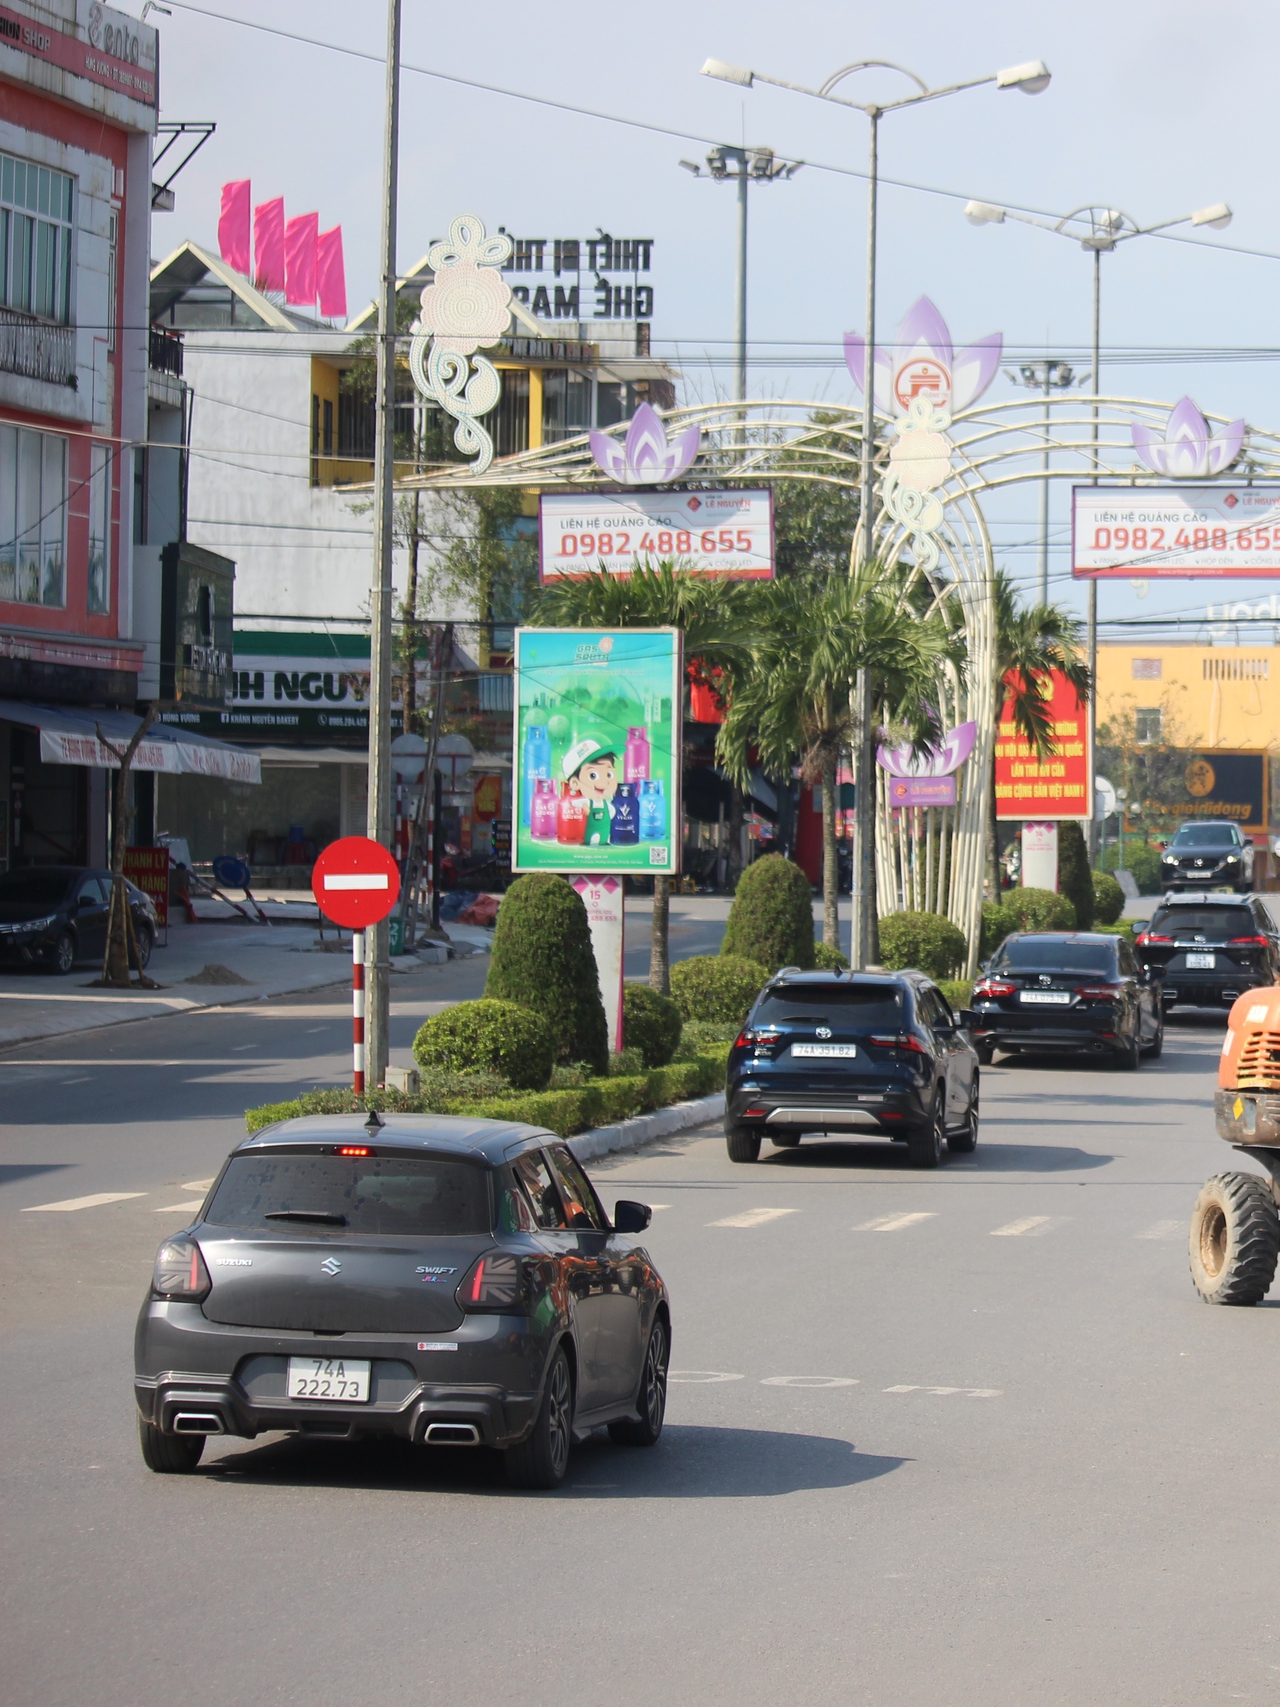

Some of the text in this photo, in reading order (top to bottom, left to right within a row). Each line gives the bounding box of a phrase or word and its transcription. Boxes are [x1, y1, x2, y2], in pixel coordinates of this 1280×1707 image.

[22, 28, 50, 52] SHOP
[560, 515, 672, 530] LIÊN HỆ QUẢNG CÁO
[1094, 512, 1208, 524] LIÊN HỆ QUẢNG CÁO
[556, 530, 753, 557] 0982.488.655
[276, 715, 299, 725] BAKERY
[589, 890, 601, 900] 15
[215, 1258, 253, 1266] SUZUKI
[415, 1265, 458, 1275] SWIFT
[312, 1360, 346, 1379] 74A
[297, 1379, 359, 1398] 222.73
